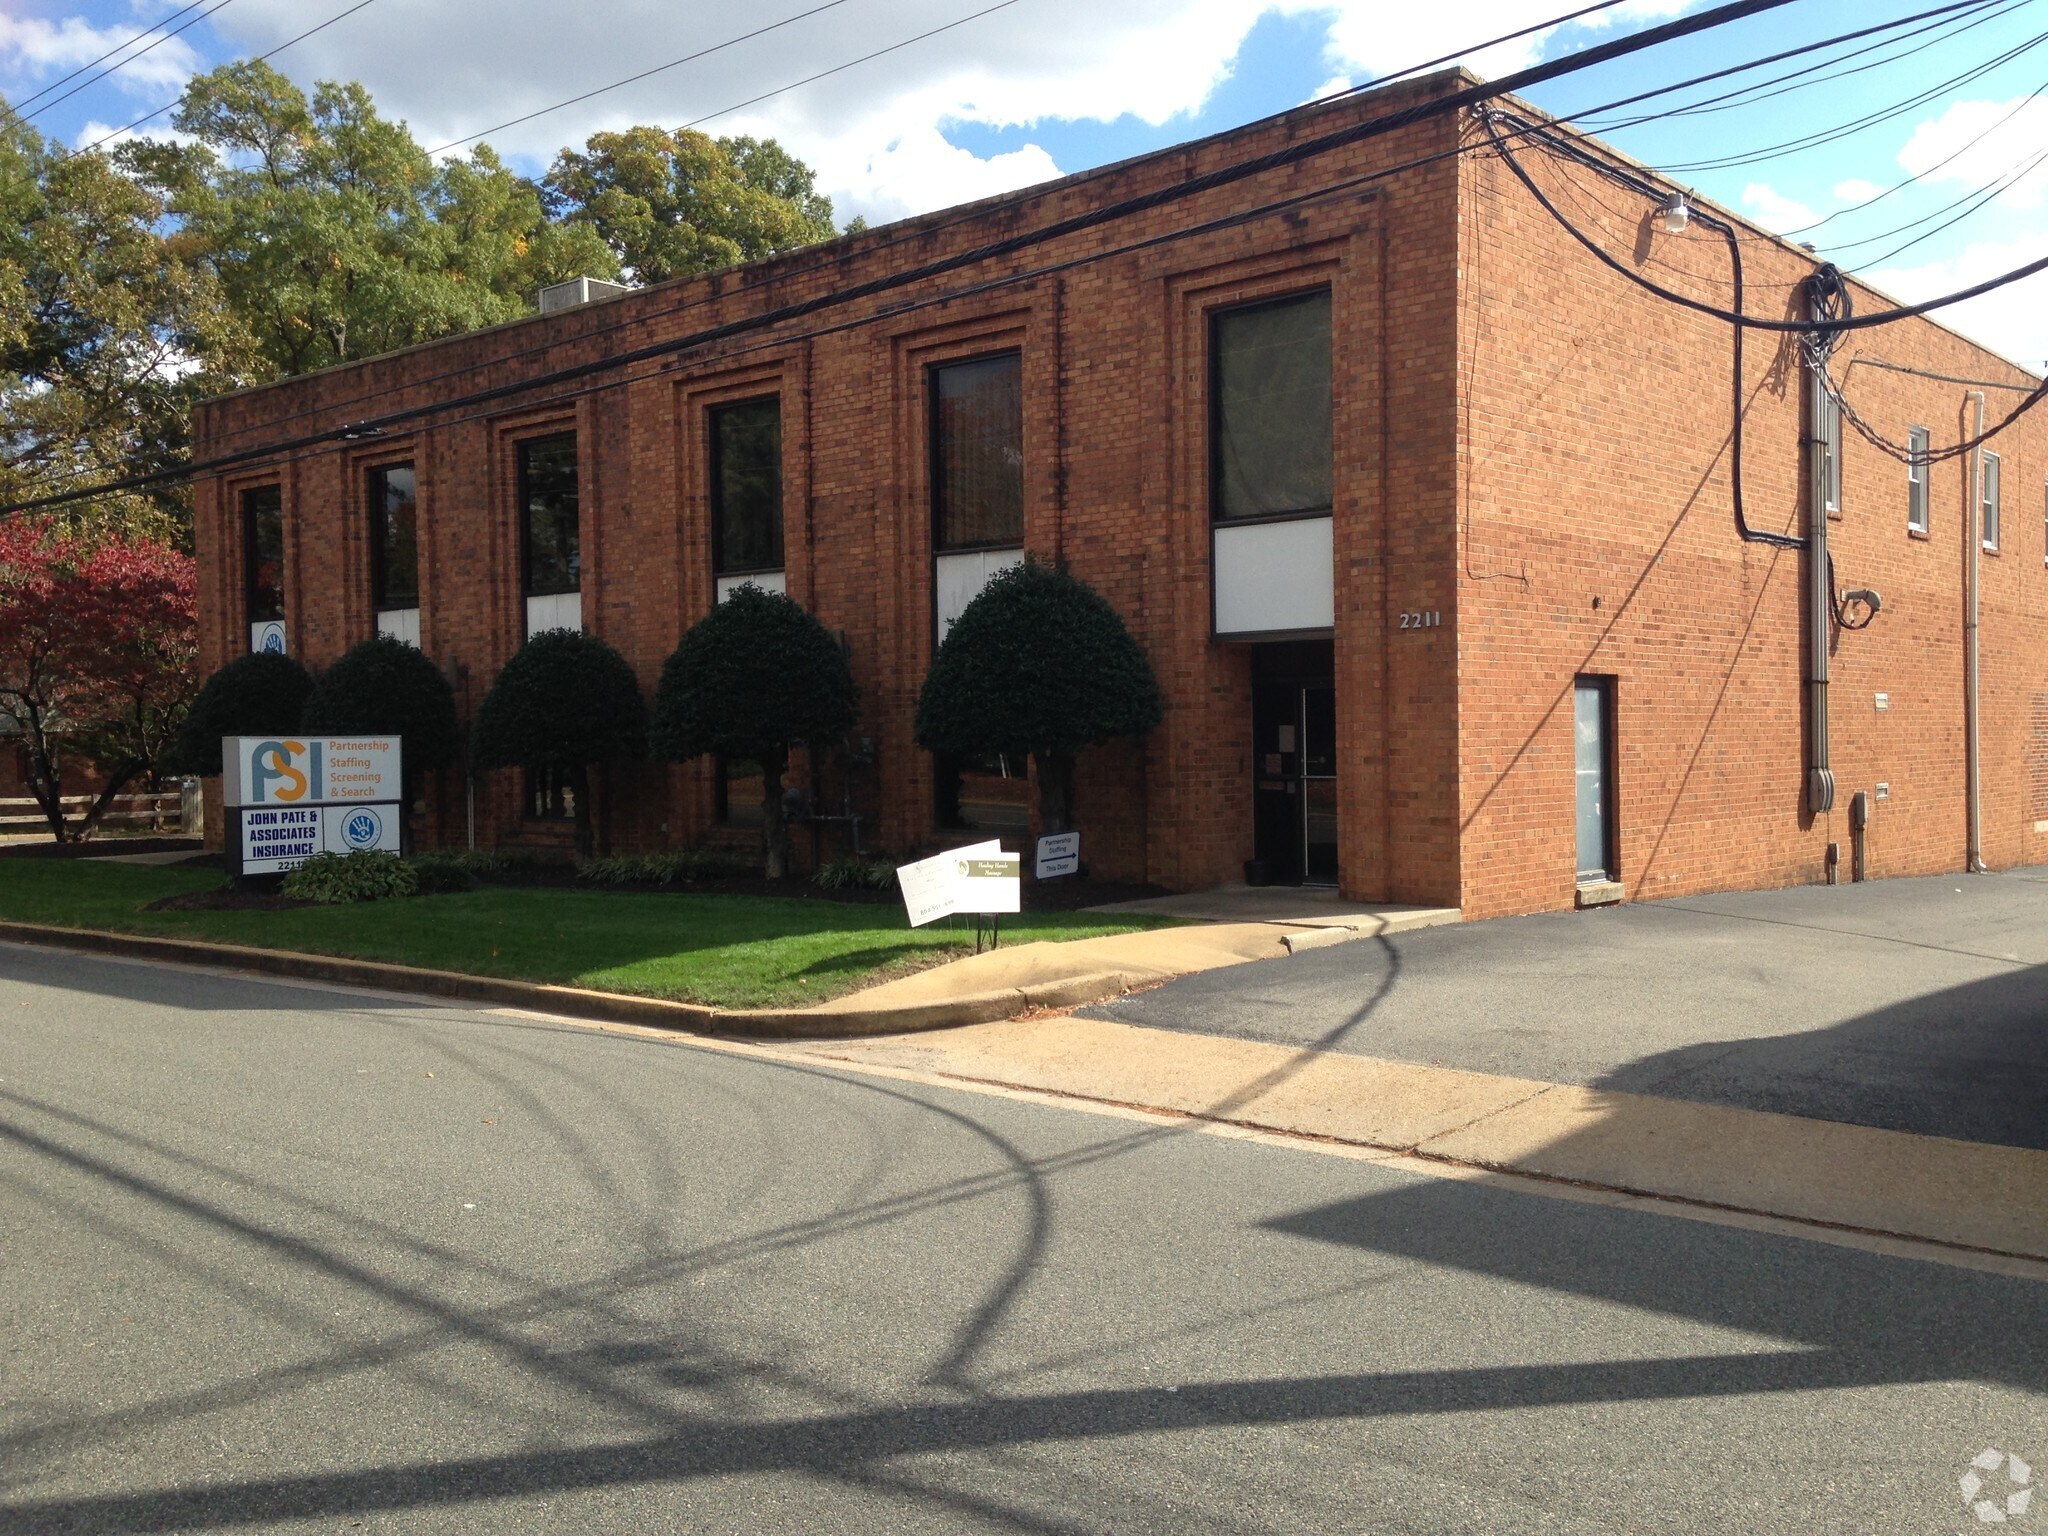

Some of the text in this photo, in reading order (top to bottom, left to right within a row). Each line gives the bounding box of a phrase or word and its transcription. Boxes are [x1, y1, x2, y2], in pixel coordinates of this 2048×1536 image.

[1400, 611, 1440, 629] 2211
[329, 741, 389, 752] Partnership
[330, 757, 371, 770] Staffing
[251, 740, 323, 802] PSI
[330, 772, 381, 783] Screening
[330, 787, 375, 797] & Search
[247, 810, 317, 826] JOHN PATE &
[250, 827, 316, 842] ASSOCIATES
[252, 843, 314, 858] INSURANCE
[1057, 863, 1070, 871] Door
